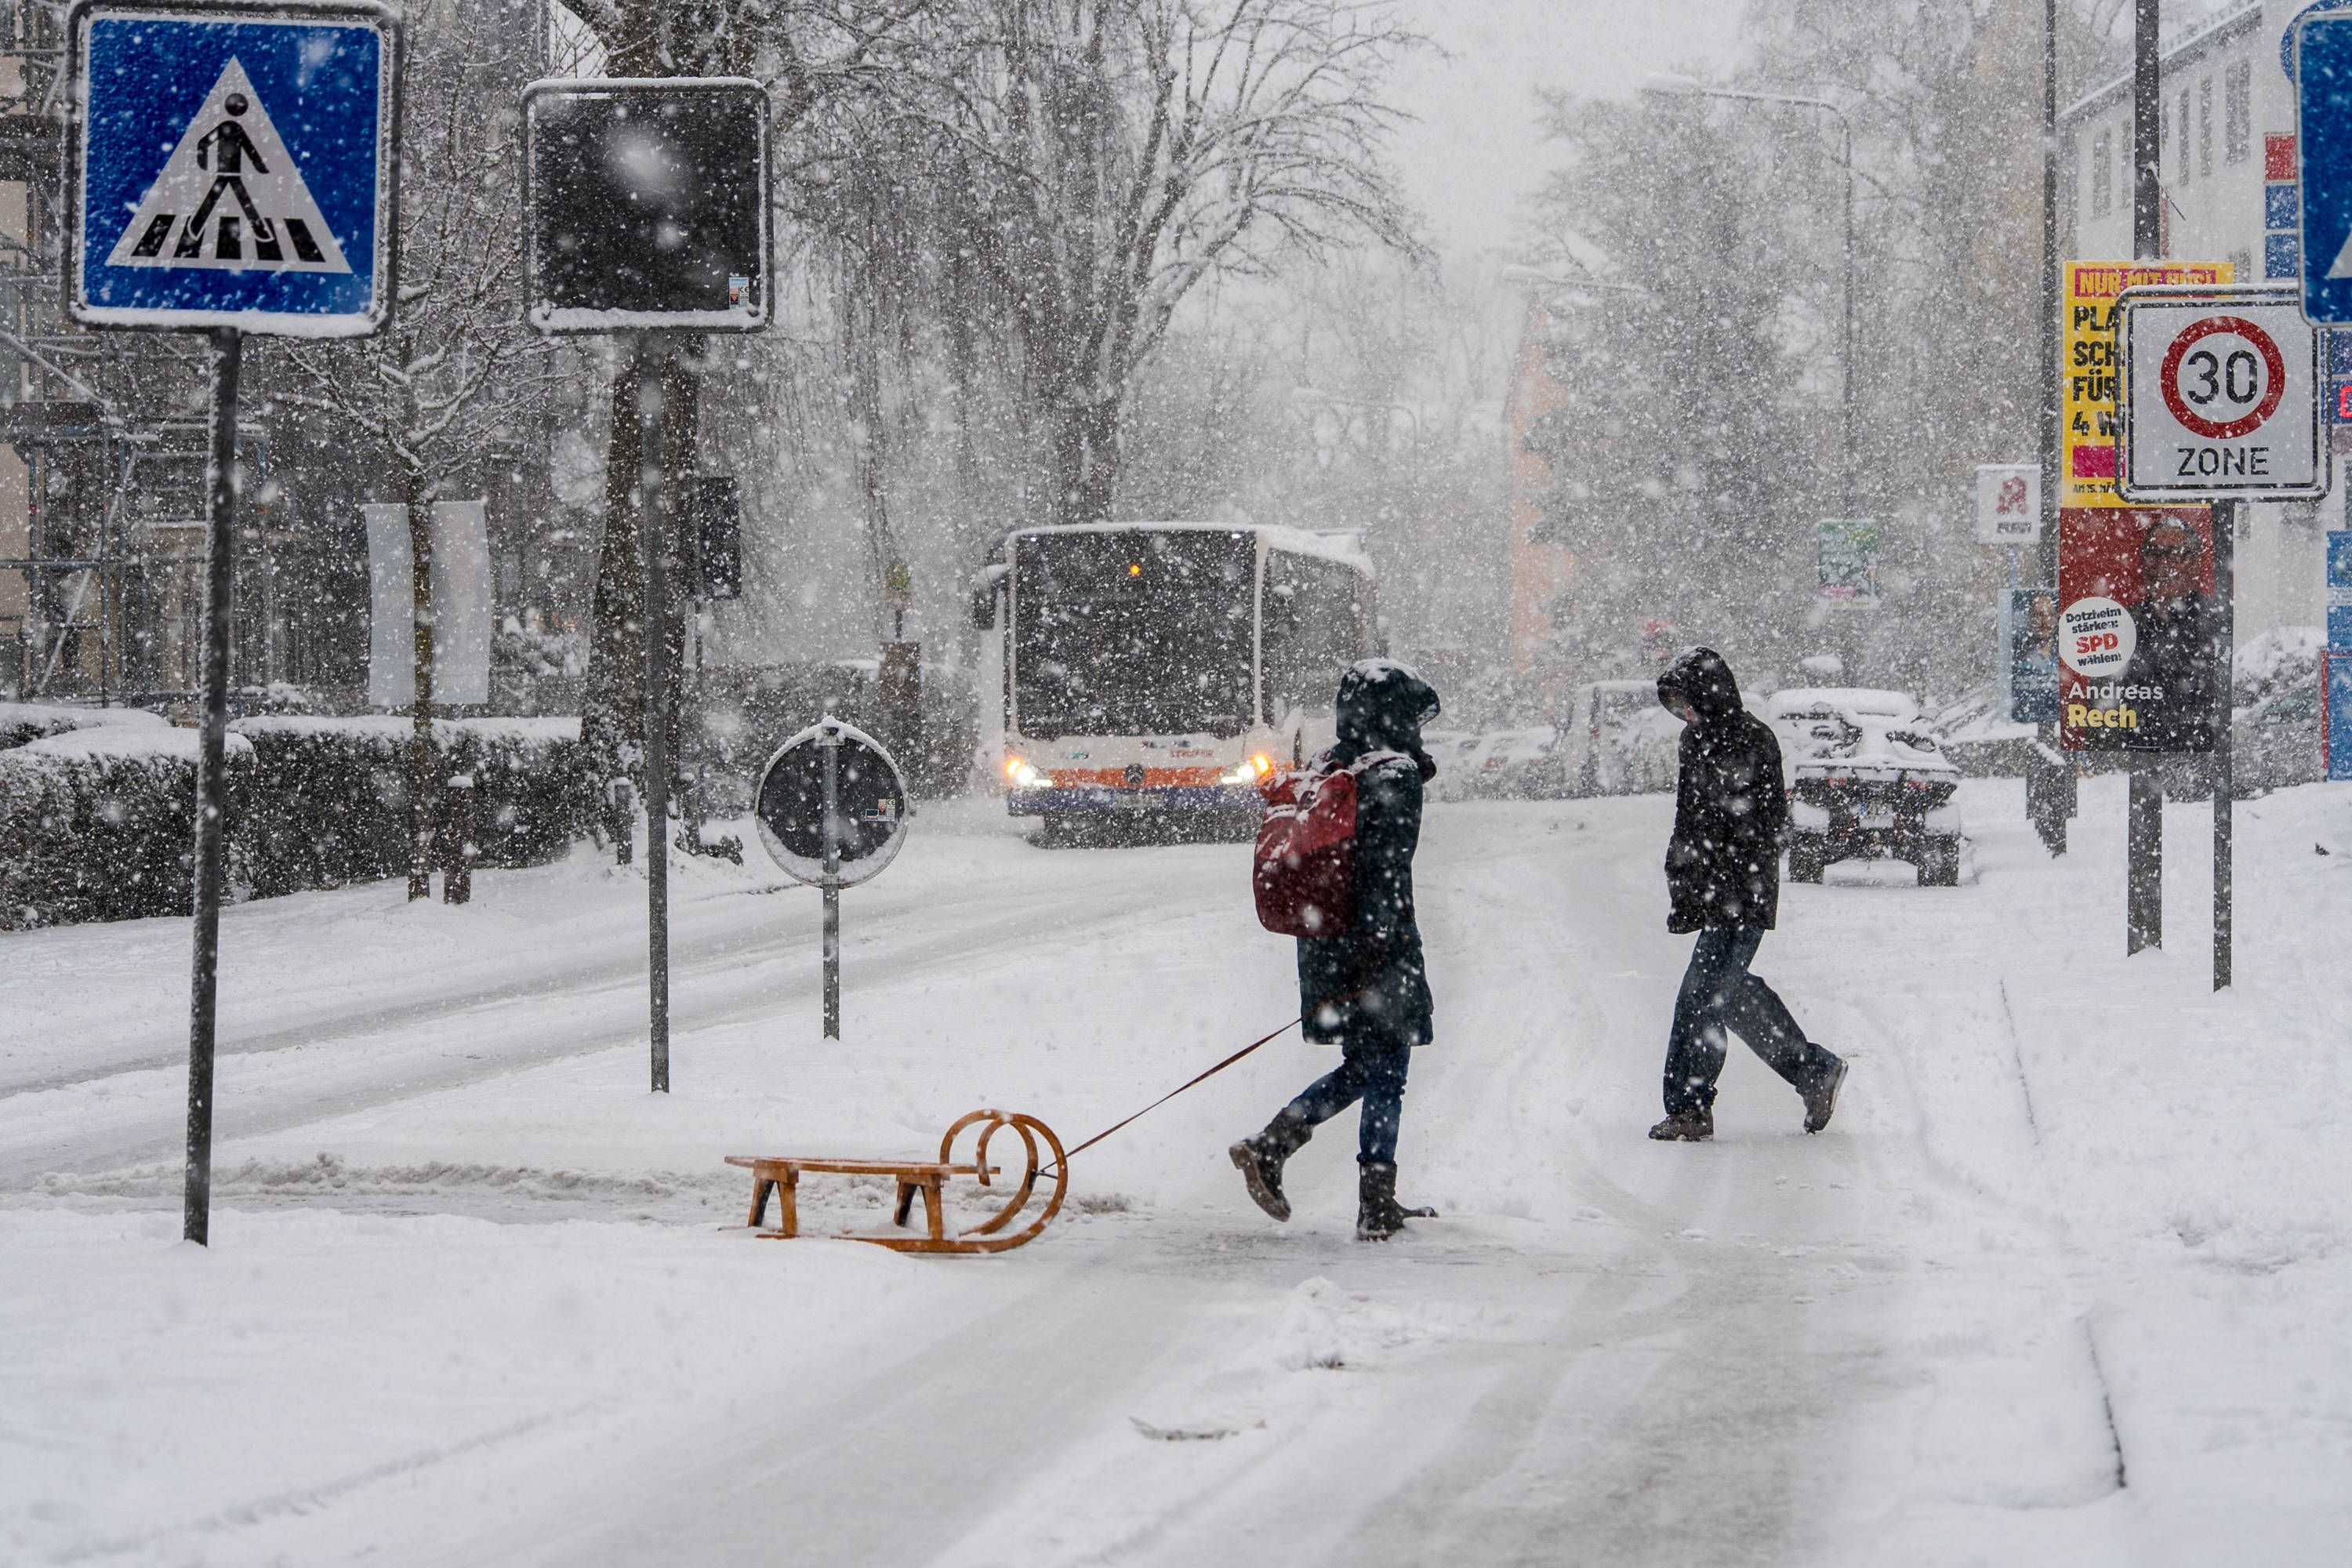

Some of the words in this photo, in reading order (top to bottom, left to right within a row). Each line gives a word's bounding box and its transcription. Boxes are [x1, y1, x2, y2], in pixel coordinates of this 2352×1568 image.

[2079, 272, 2122, 294] NUR
[2074, 307, 2117, 332] PLA
[2073, 341, 2120, 367] SCH
[2073, 368, 2117, 401] FÜR
[2187, 350, 2258, 405] 30
[2072, 411, 2089, 436] 4
[2177, 447, 2270, 477] ZONE
[2066, 608, 2122, 623] Dotzheim
[2071, 620, 2119, 633] stärken:
[2076, 633, 2119, 654] SPD
[2078, 652, 2122, 666] wählen!
[2068, 681, 2164, 700] Andreas
[2068, 703, 2137, 728] Rech
